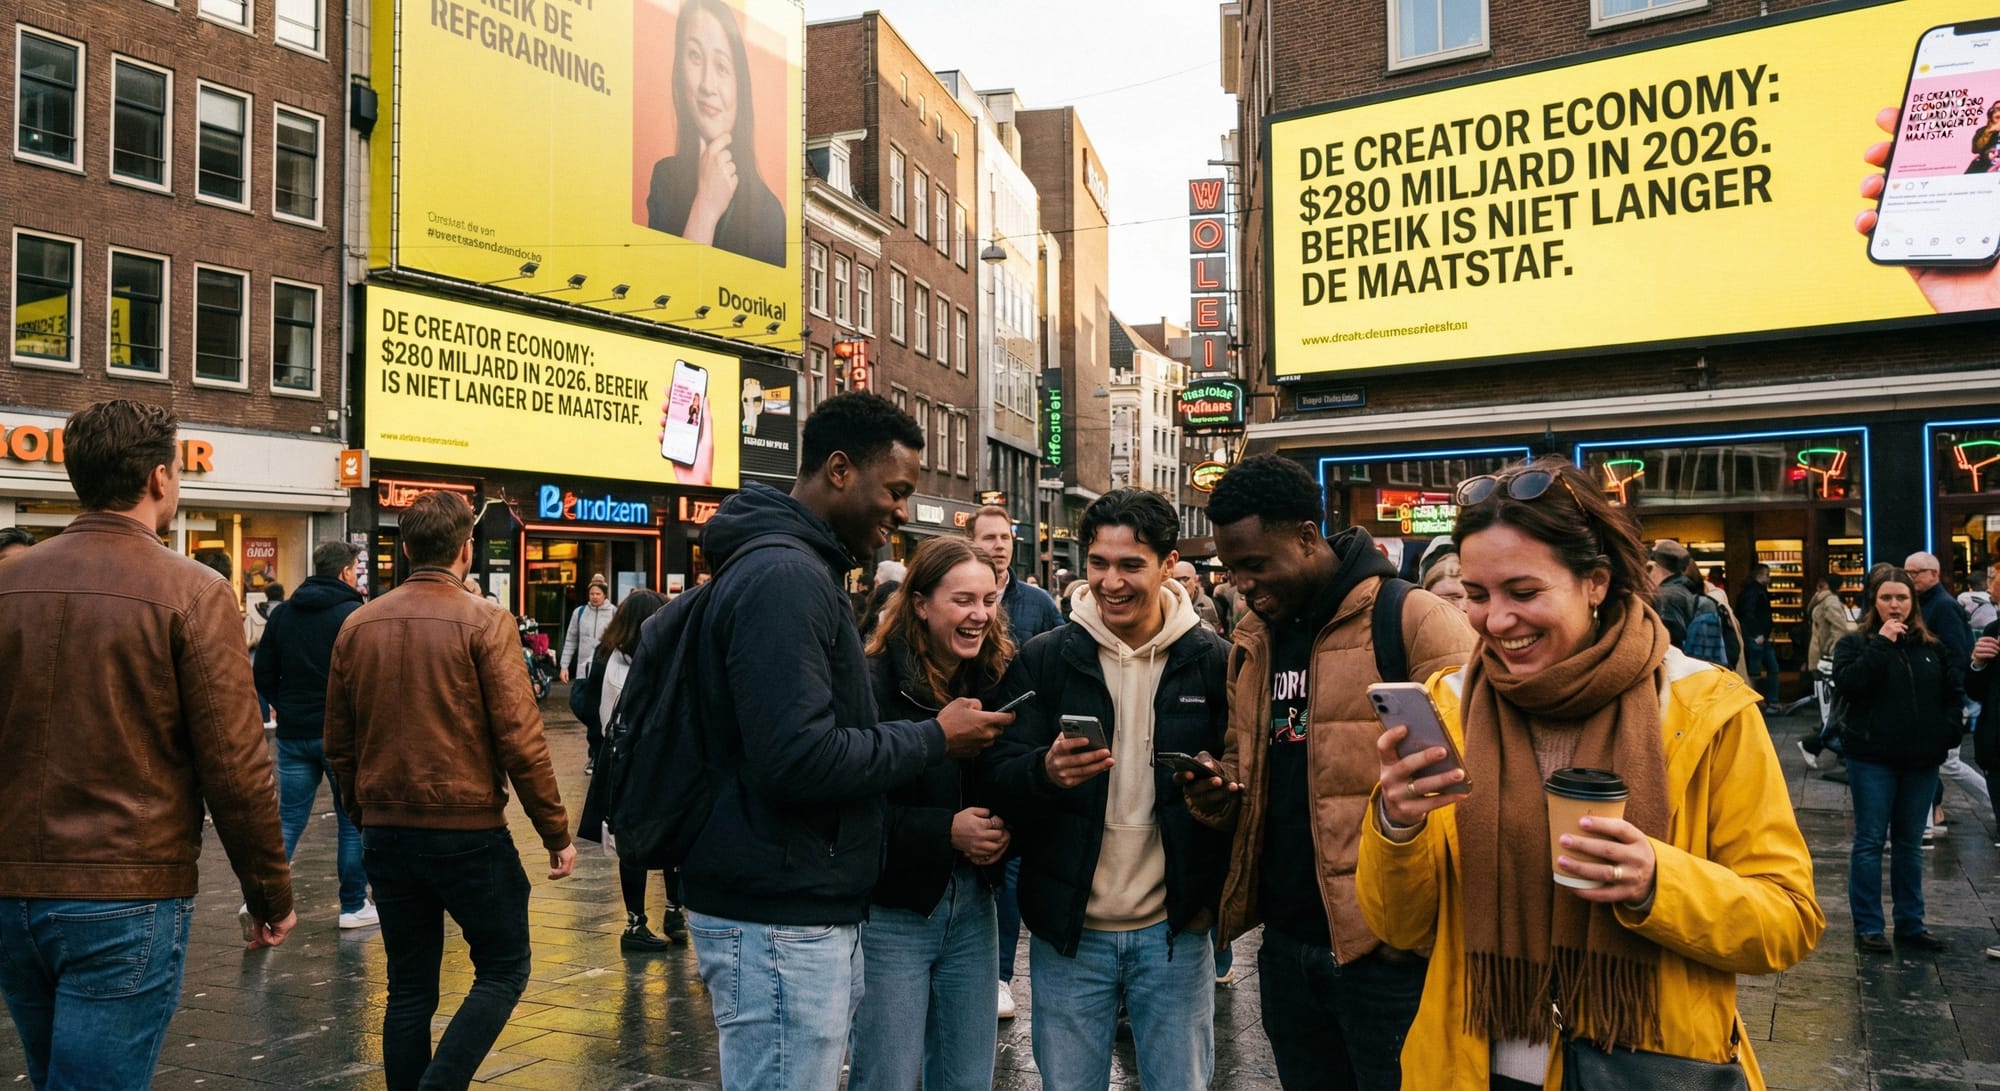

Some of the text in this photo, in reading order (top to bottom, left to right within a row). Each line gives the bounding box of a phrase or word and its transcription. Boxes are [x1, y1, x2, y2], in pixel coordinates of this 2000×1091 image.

[431, 0, 611, 97] REFGRARNING.
[544, 2, 573, 42] DE
[1301, 64, 1779, 181] DE CREATOR ECONOMY:
[1300, 117, 1771, 225] $280 MILJARD IN 2026.
[1302, 165, 1773, 264] BEREIK IS NIET LANGER
[718, 286, 786, 322] Doorikal
[1303, 240, 1573, 307] DE MAATSTAF.
[381, 337, 433, 368] $280
[439, 348, 518, 380] MILJARD
[523, 361, 541, 384] IN
[545, 366, 591, 393] 2026.
[595, 373, 649, 400] BEREIK
[382, 309, 594, 367] DE CREATOR ECONOMY:
[382, 369, 400, 394] IS
[407, 373, 450, 400] NIET
[455, 380, 527, 410] LANGER
[532, 391, 554, 414] DE
[558, 395, 642, 425] MAATSTAF.
